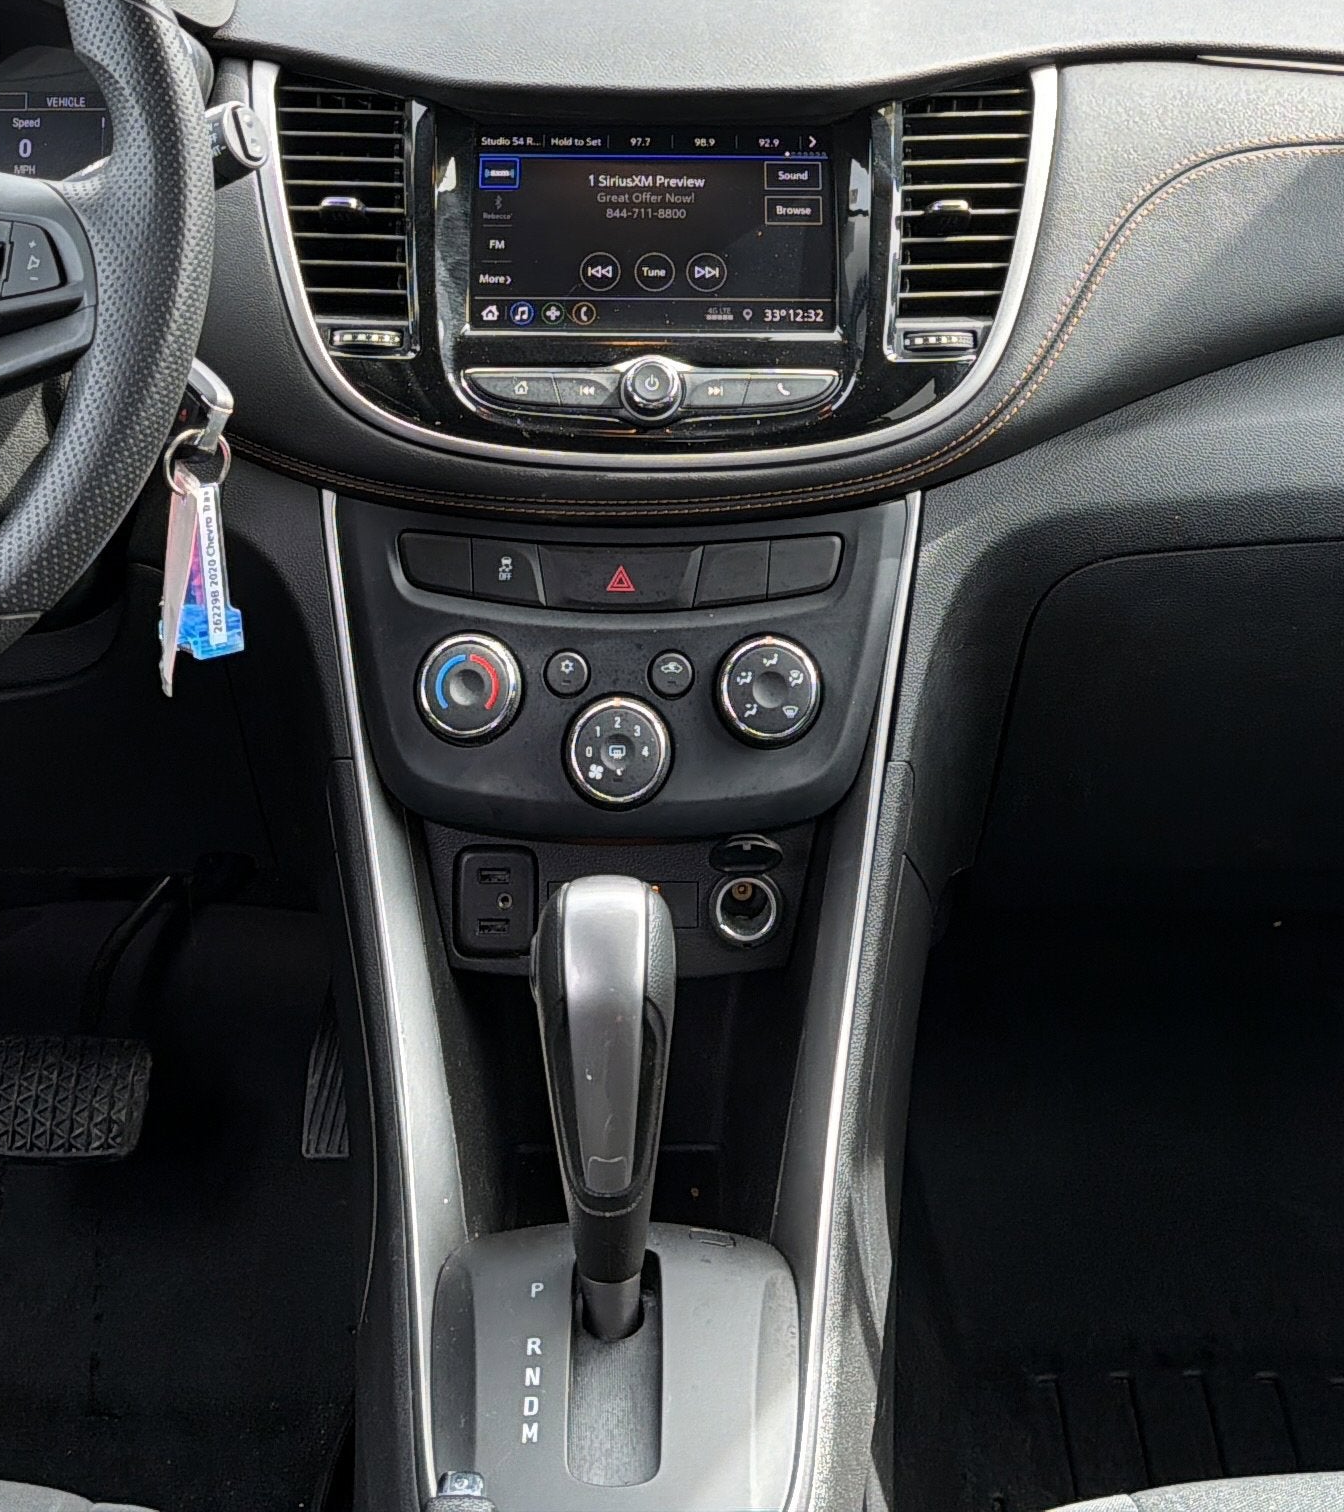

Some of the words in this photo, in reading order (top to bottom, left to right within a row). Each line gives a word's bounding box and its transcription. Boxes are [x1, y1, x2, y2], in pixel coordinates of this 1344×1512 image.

[46, 97, 86, 108] VEHICLE
[12, 117, 40, 129] Speed
[481, 136, 510, 146] Studio
[512, 136, 524, 146] 54
[550, 137, 572, 146] Hold
[574, 138, 584, 146] to
[586, 137, 602, 146] Set
[630, 138, 651, 147] 97.7
[694, 138, 716, 147] 98.9
[758, 138, 780, 148] 92.9
[18, 138, 32, 158] 0
[14, 165, 36, 175] MPH
[778, 170, 808, 180] Sound
[588, 175, 595, 187] 1
[598, 175, 653, 187] SiriusXM
[656, 175, 706, 188] Preview
[597, 193, 629, 203] Great
[632, 192, 663, 203] Offer
[665, 192, 695, 203] Now!
[606, 208, 687, 219] 844-711-8800
[776, 205, 812, 216] Browse
[489, 240, 505, 249] FM
[642, 266, 666, 277] Tune
[479, 274, 504, 284] More
[788, 309, 824, 322] 12:32
[208, 559, 219, 588] 2020
[585, 746, 593, 757] 0
[595, 726, 601, 737] 1
[614, 717, 621, 728] 2
[634, 725, 641, 736] 3
[641, 746, 649, 757] 4
[530, 1282, 544, 1298] P
[526, 1337, 542, 1355] R
[525, 1367, 541, 1386] N
[523, 1396, 539, 1416] D
[521, 1422, 539, 1444] M
